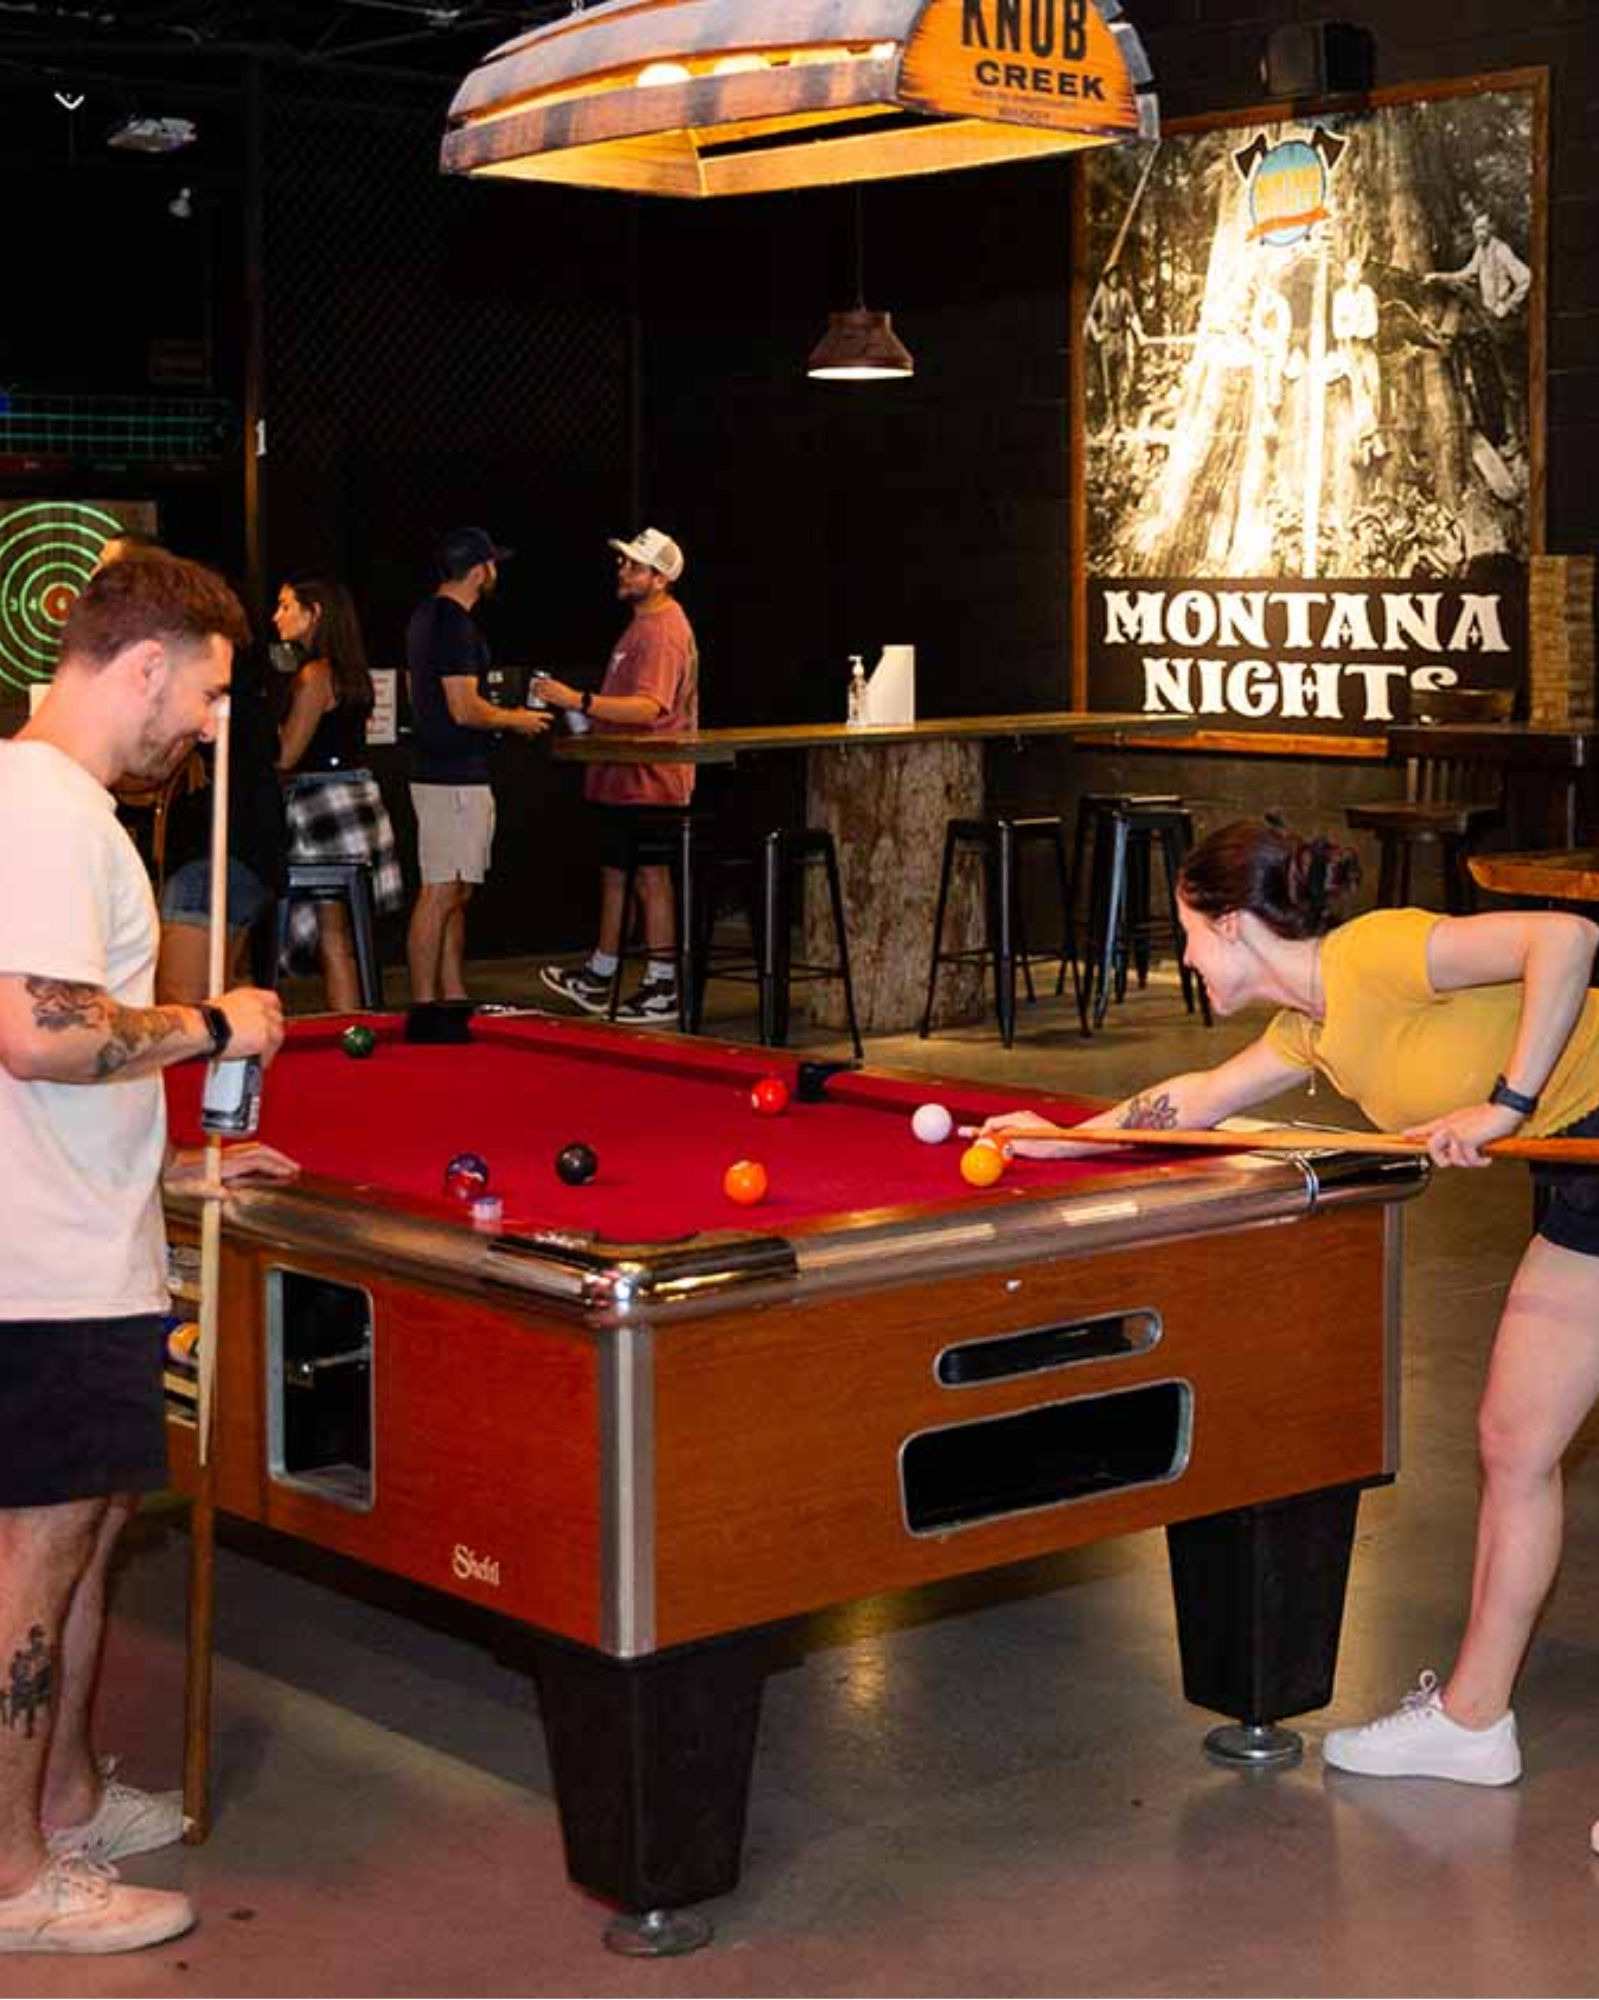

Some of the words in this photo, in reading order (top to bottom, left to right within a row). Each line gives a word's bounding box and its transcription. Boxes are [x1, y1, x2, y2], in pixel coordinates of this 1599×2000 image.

[961, 0, 1087, 61] KNOB
[975, 60, 1105, 100] CREEK
[1103, 590, 1511, 652] MONTANA
